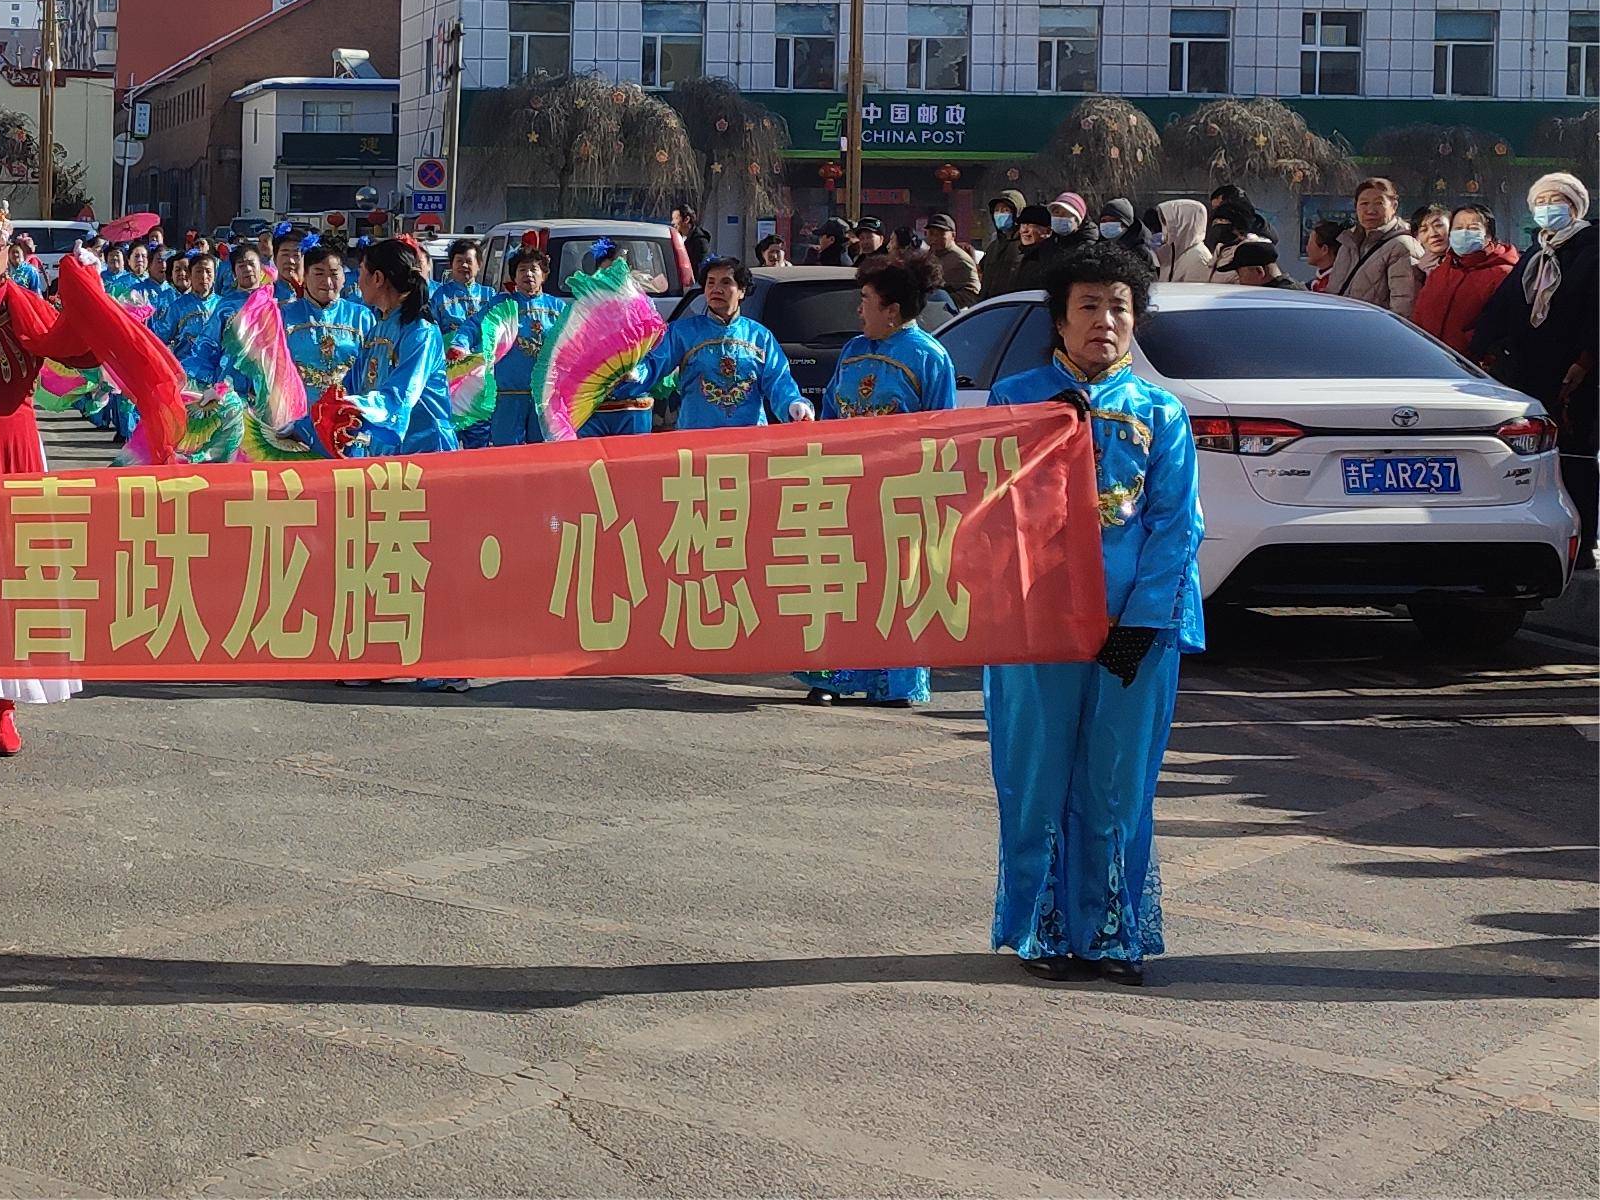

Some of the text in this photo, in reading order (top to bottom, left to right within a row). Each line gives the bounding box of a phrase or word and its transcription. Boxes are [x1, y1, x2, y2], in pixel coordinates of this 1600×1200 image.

[861, 102, 966, 126] 中国邮政
[861, 129, 966, 145] CHINA POST
